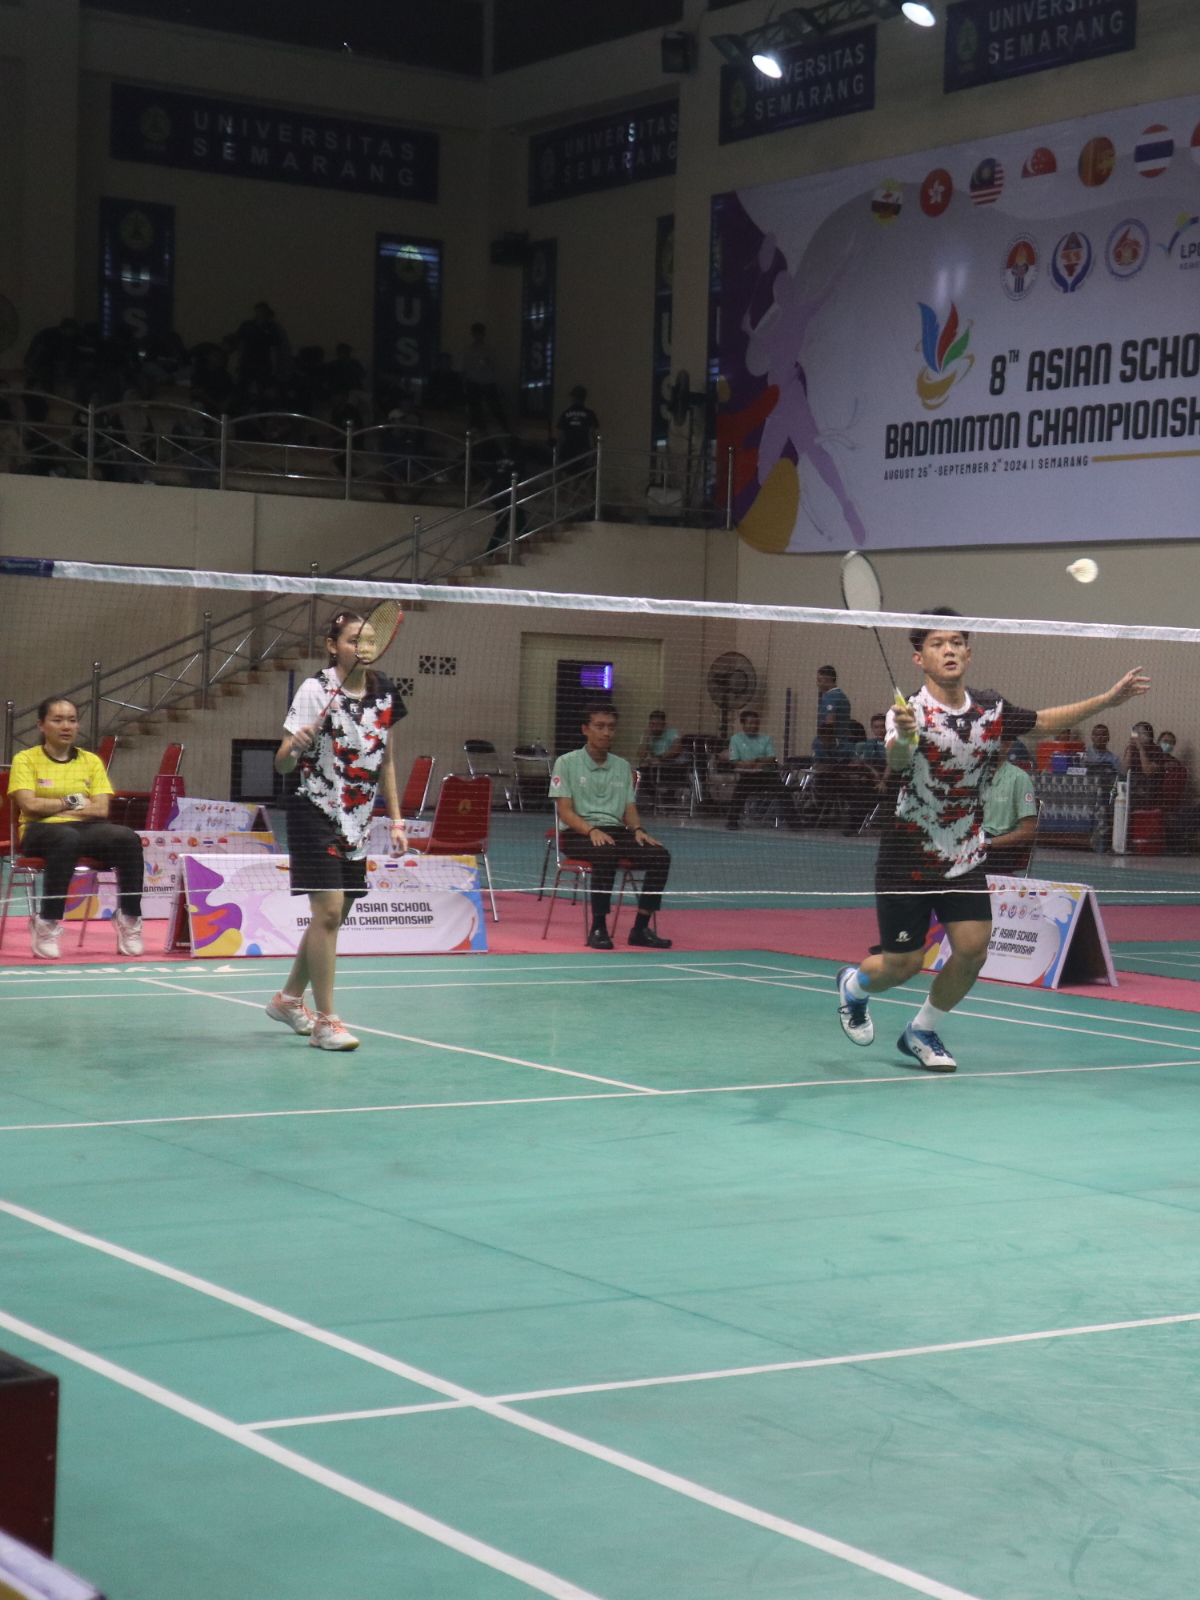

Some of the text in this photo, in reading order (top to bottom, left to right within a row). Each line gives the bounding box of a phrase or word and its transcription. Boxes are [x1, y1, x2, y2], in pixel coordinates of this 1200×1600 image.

[988, 10, 1124, 65] SEMARANG
[754, 73, 864, 120] SEMARANG
[193, 110, 415, 162] UNIVERSITAS
[193, 137, 414, 187] SEMARANG
[988, 349, 1020, 397] 8TH
[1026, 342, 1112, 392] ASIAN
[884, 410, 1022, 460] BADMINTON
[884, 466, 915, 480] AUGUST
[1003, 459, 1027, 472] 2024
[1038, 456, 1089, 470] SEMARANG
[355, 902, 433, 913] ASIAN SCHOOL
[359, 915, 434, 926] CHAMPIONSHIP
[996, 941, 1036, 956] CHAMPIONSHIP
[1016, 930, 1039, 943] SCHOOL
